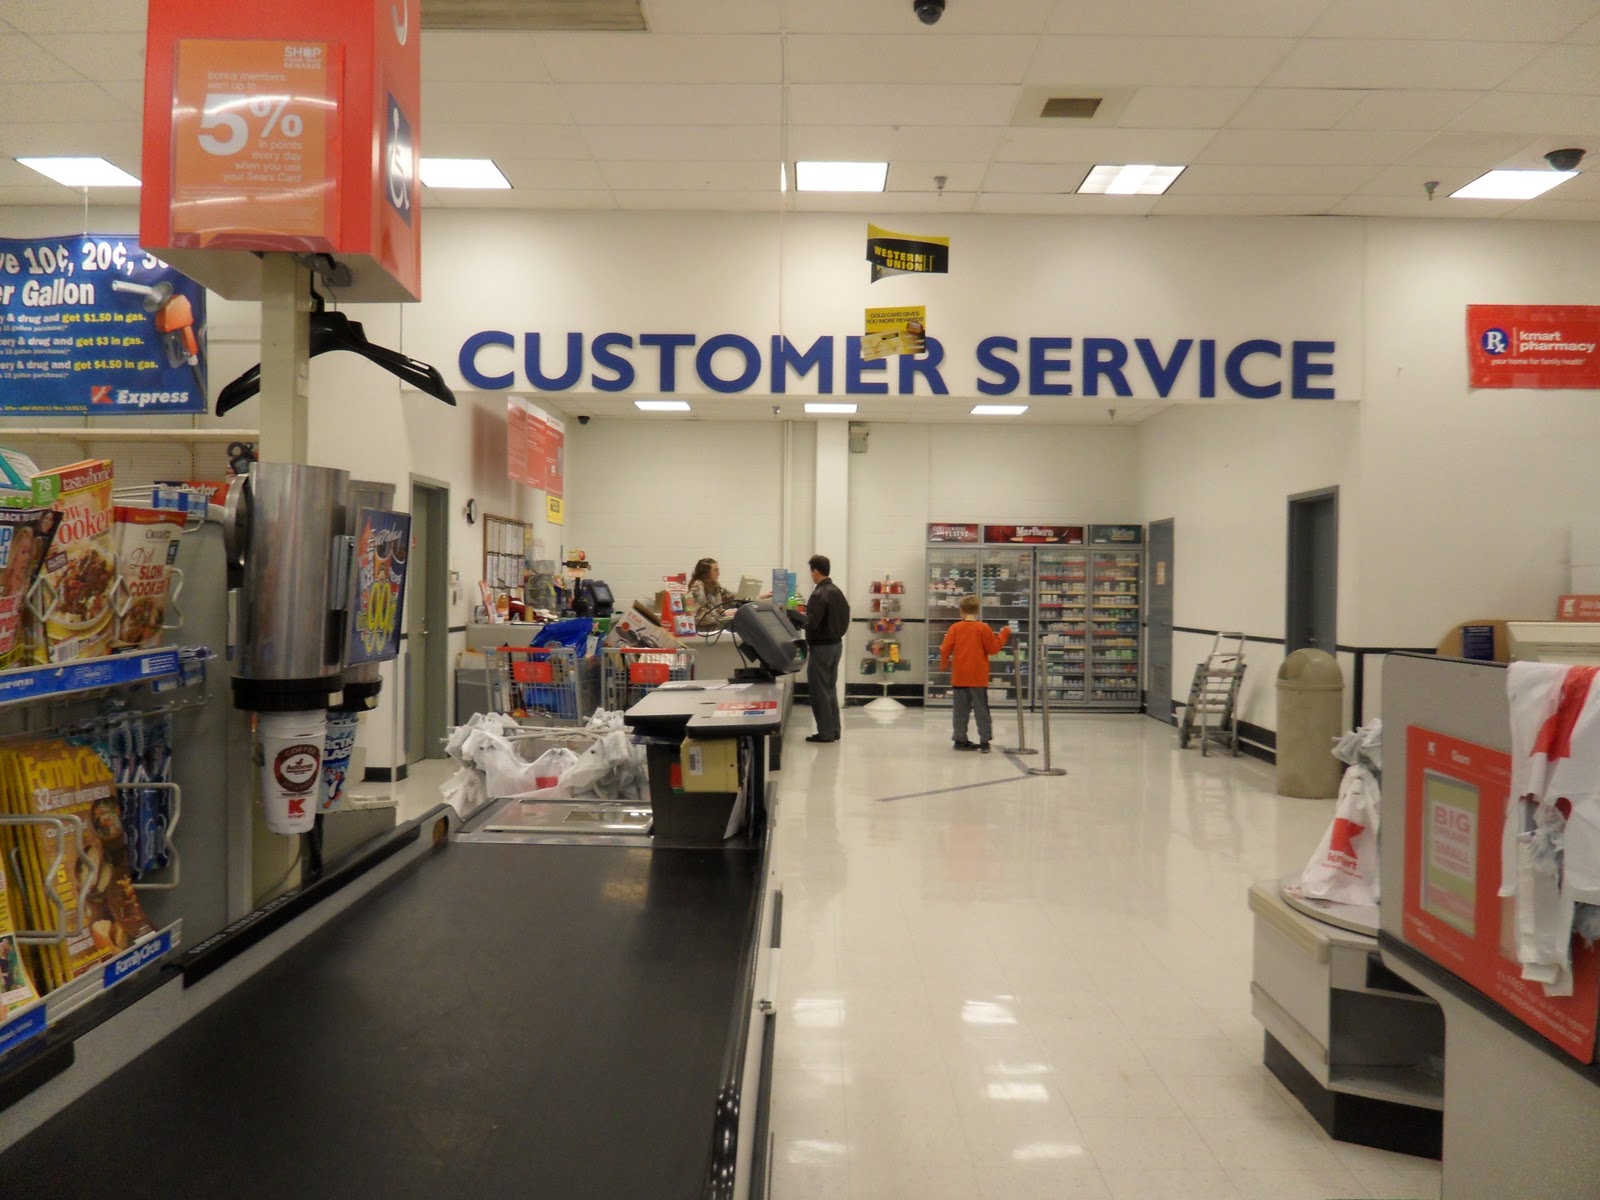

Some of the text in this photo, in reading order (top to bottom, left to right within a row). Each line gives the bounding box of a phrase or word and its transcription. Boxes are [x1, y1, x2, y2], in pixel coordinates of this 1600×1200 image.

[258, 140, 302, 150] in points
[252, 151, 302, 160] every day
[223, 172, 301, 182] your Sears Card
[82, 242, 134, 276] 20¢,
[873, 245, 924, 263] WESTERN
[886, 258, 923, 271] UNION
[22, 278, 95, 307] Gallon
[6, 313, 15, 322] &
[18, 313, 41, 324] drug
[43, 313, 60, 322] and
[62, 313, 80, 323] get
[83, 313, 112, 323] $1.50
[114, 313, 123, 322] in
[125, 313, 147, 323] gas.
[18, 336, 25, 345] &
[28, 337, 50, 347] drug
[53, 337, 73, 346] and
[76, 338, 94, 347] get
[97, 336, 109, 346] $3
[111, 336, 120, 346] in
[122, 337, 144, 347] gas.
[1519, 331, 1562, 341] kmart
[1519, 341, 1596, 354] pharmacy
[16, 360, 25, 370] &
[27, 361, 49, 371] drug
[51, 361, 71, 370] and
[74, 362, 91, 371] get
[94, 360, 122, 369] $4.50
[125, 360, 134, 369] in
[137, 360, 158, 370] gas.
[458, 330, 1336, 400] CUSTOMER SERVICE
[117, 389, 189, 408] Express
[1015, 526, 1054, 537] Marlboro
[1434, 806, 1471, 834] BIG
